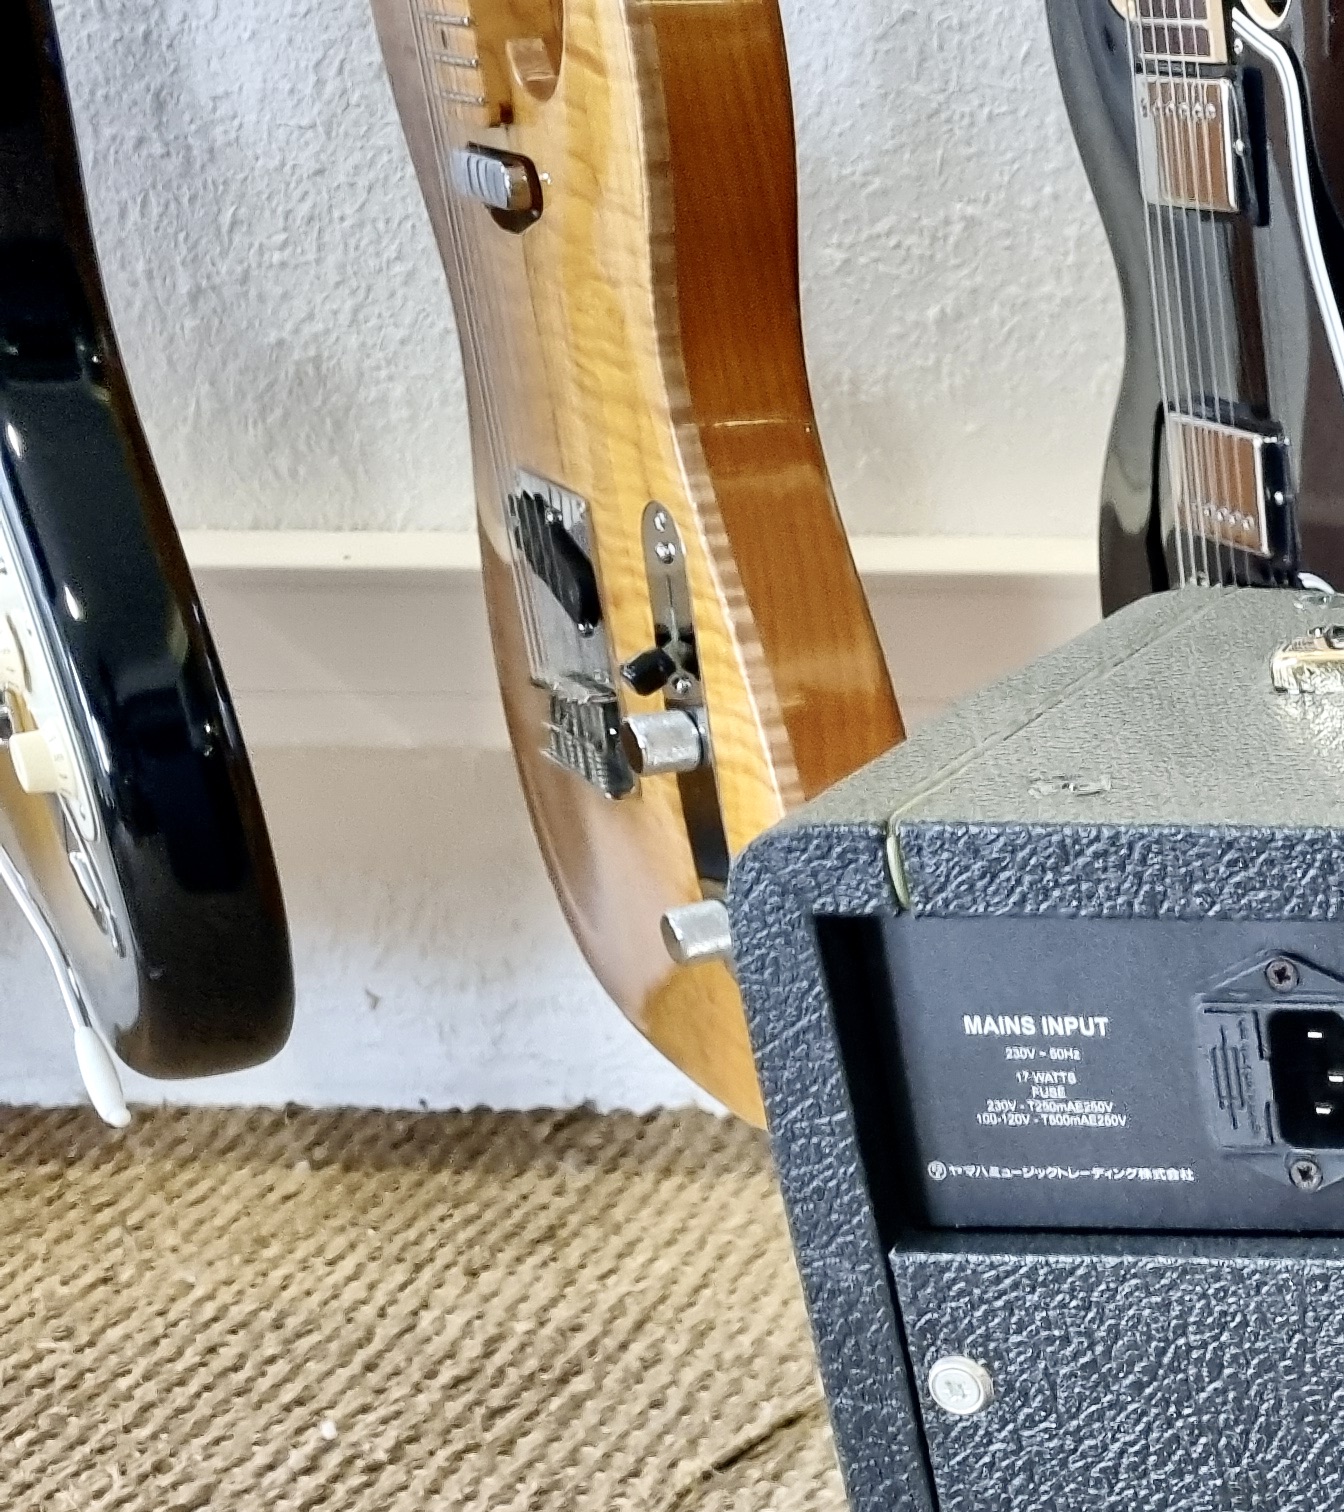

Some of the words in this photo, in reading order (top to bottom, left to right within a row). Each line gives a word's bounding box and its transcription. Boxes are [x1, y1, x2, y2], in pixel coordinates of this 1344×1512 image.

[963, 1015, 1036, 1036] MAINS
[1042, 1016, 1109, 1037] INPUT
[1005, 1047, 1036, 1060] 230V
[1032, 1071, 1077, 1085] WATTS
[1031, 1085, 1067, 1099] FUSE
